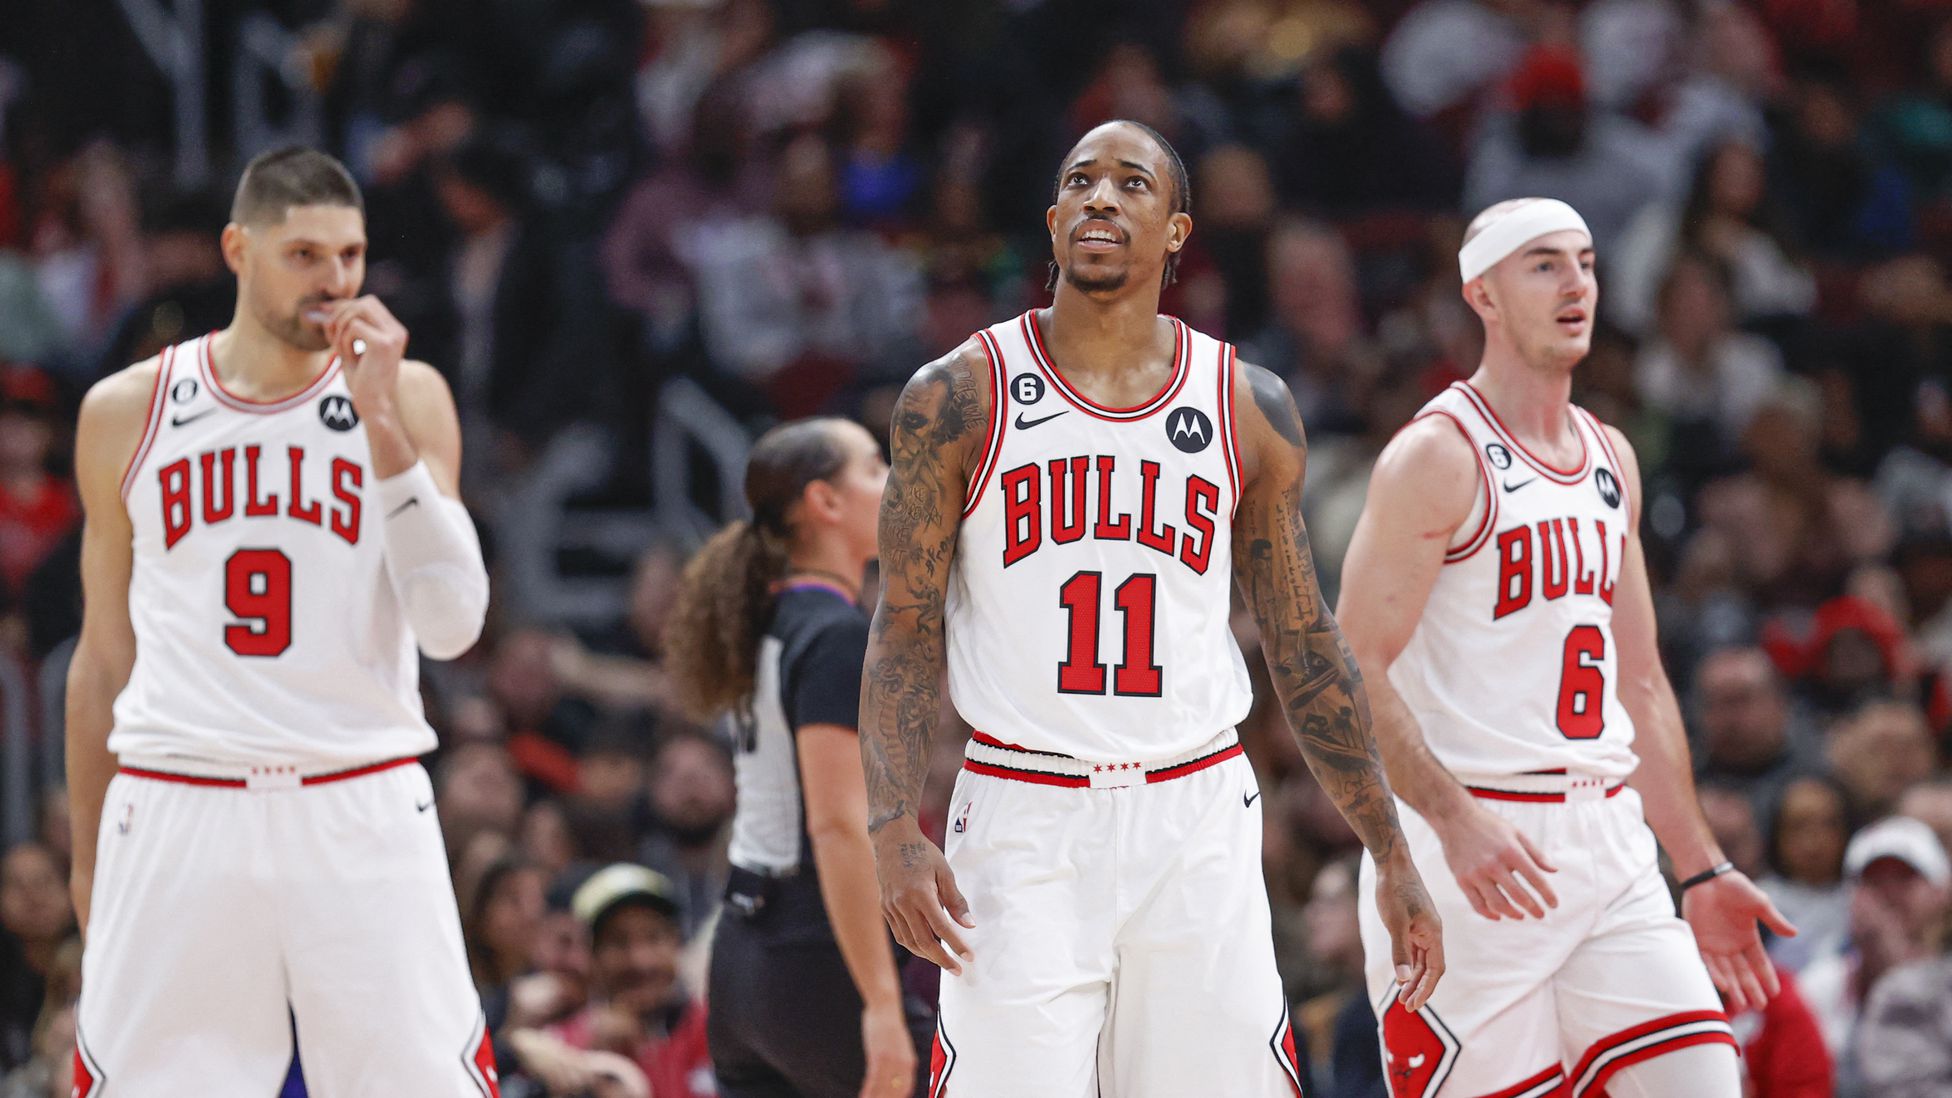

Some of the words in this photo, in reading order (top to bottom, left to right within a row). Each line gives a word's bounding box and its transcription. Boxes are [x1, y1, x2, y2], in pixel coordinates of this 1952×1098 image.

[1018, 377, 1037, 401] 6
[158, 444, 363, 552] BULLS
[1488, 445, 1509, 469] 6
[1001, 454, 1221, 577] BULLS
[1493, 516, 1627, 621] BULL
[224, 547, 292, 658] 9
[1057, 570, 1163, 697] 11
[1556, 624, 1605, 740] 6
